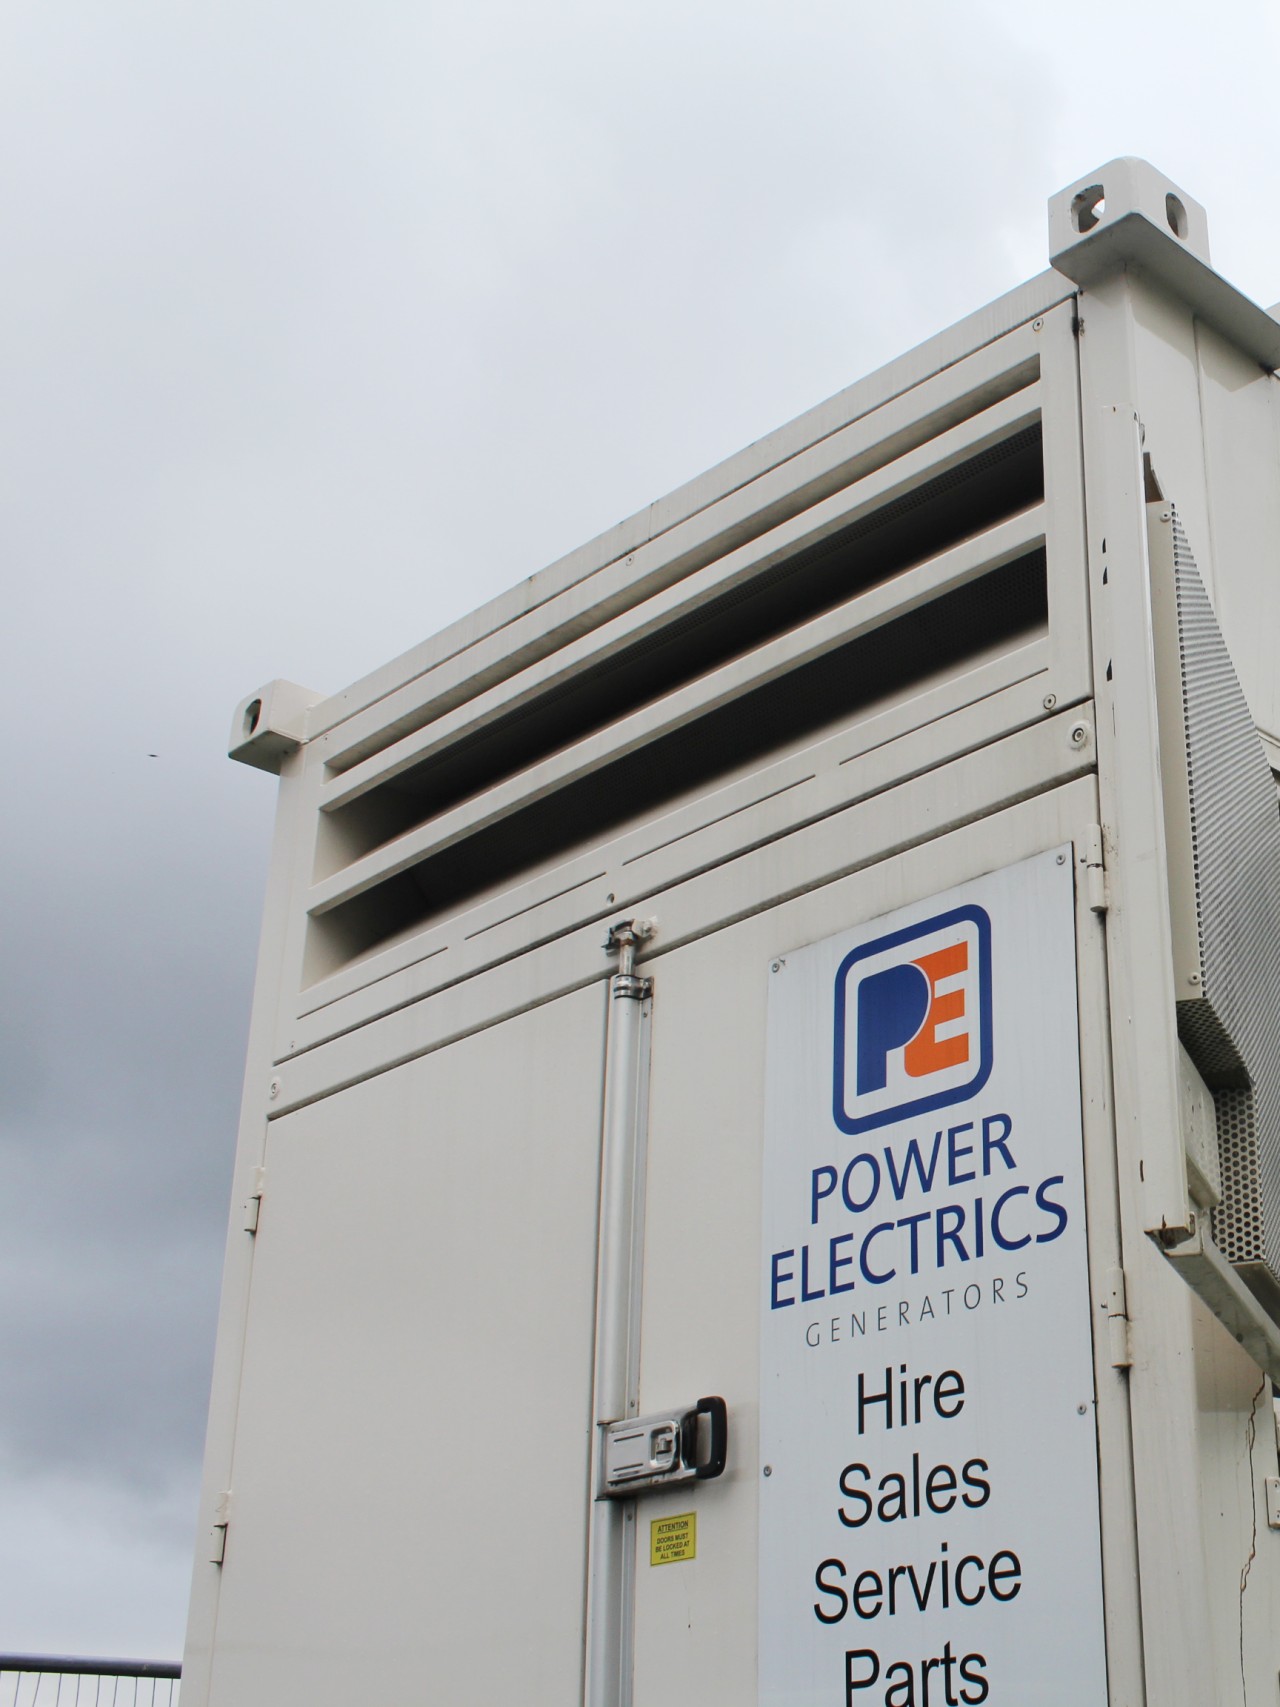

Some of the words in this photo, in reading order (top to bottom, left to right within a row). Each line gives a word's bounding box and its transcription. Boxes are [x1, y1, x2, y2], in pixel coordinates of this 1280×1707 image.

[811, 1113, 1017, 1225] POWER
[771, 1175, 1069, 1310] ELECTRICS
[806, 1272, 1030, 1348] GENERATORS
[858, 1363, 965, 1435] Hire
[838, 1452, 991, 1528] Sales
[655, 1545, 662, 1553] BE
[663, 1542, 683, 1552] LOCKED
[656, 1535, 674, 1545] DOORS
[675, 1532, 688, 1541] MUST
[657, 1520, 689, 1533] ATTENTION
[671, 1549, 685, 1557] TIMES
[814, 1541, 1022, 1625] Service
[845, 1640, 990, 1707] Parts
